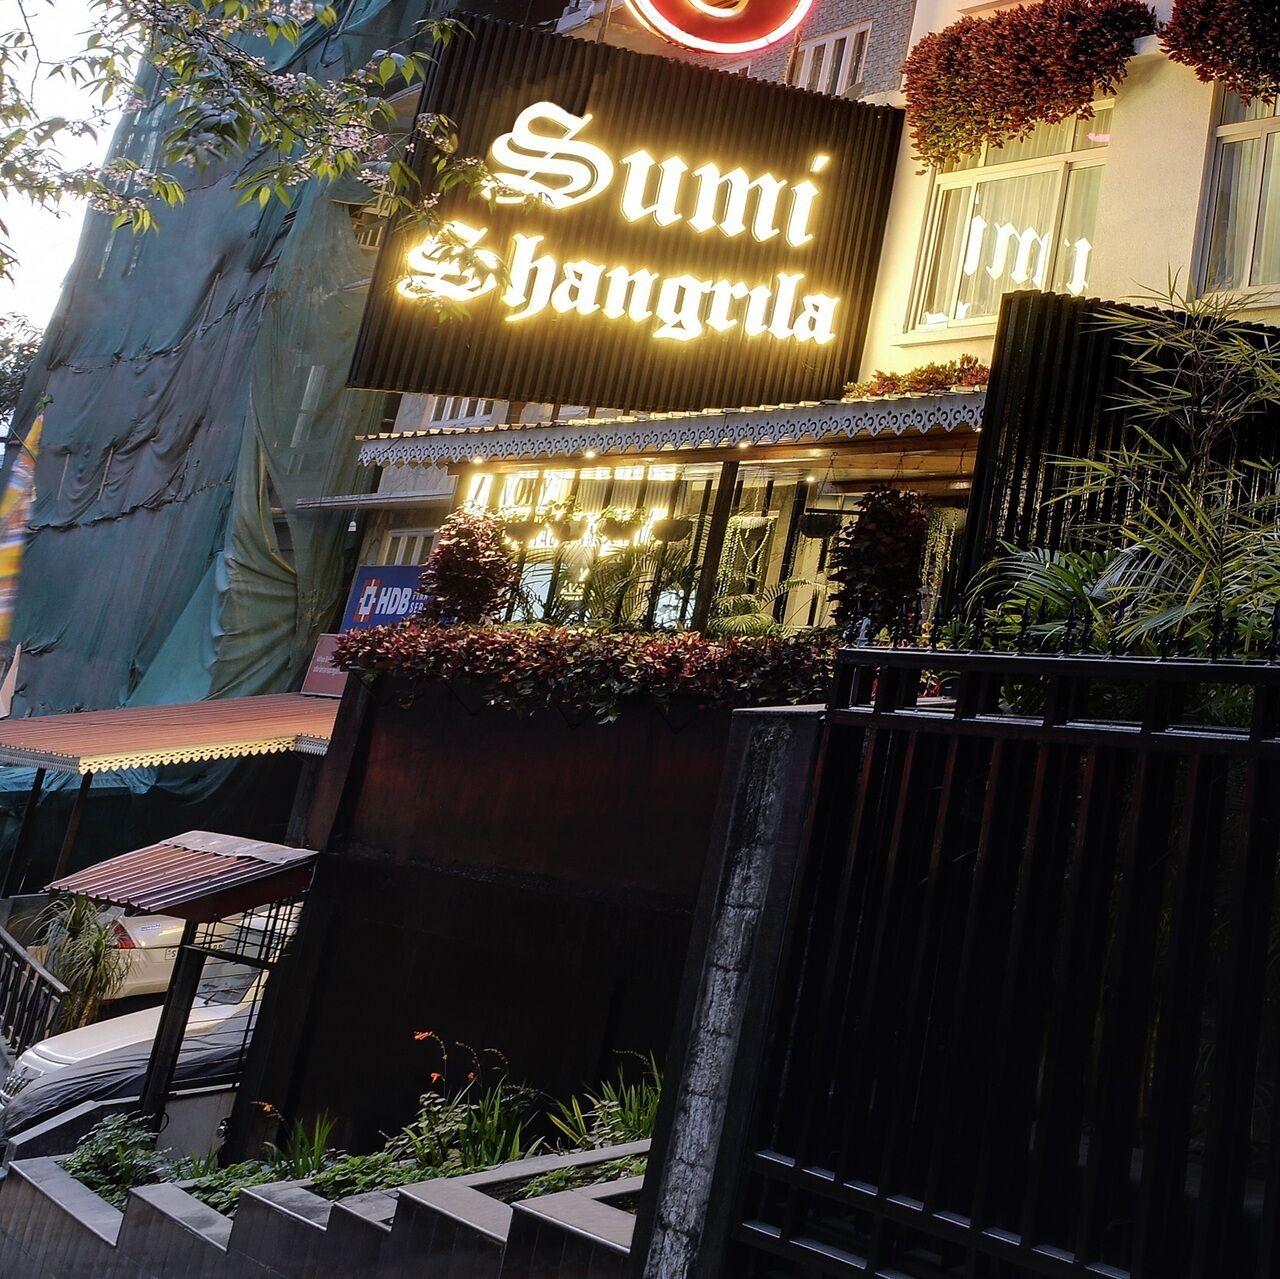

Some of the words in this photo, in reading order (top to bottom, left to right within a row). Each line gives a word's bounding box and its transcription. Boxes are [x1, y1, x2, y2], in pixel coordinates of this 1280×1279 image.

[480, 101, 830, 248] Sumi
[396, 220, 840, 346] Shangrila
[375, 587, 412, 615] HDB
